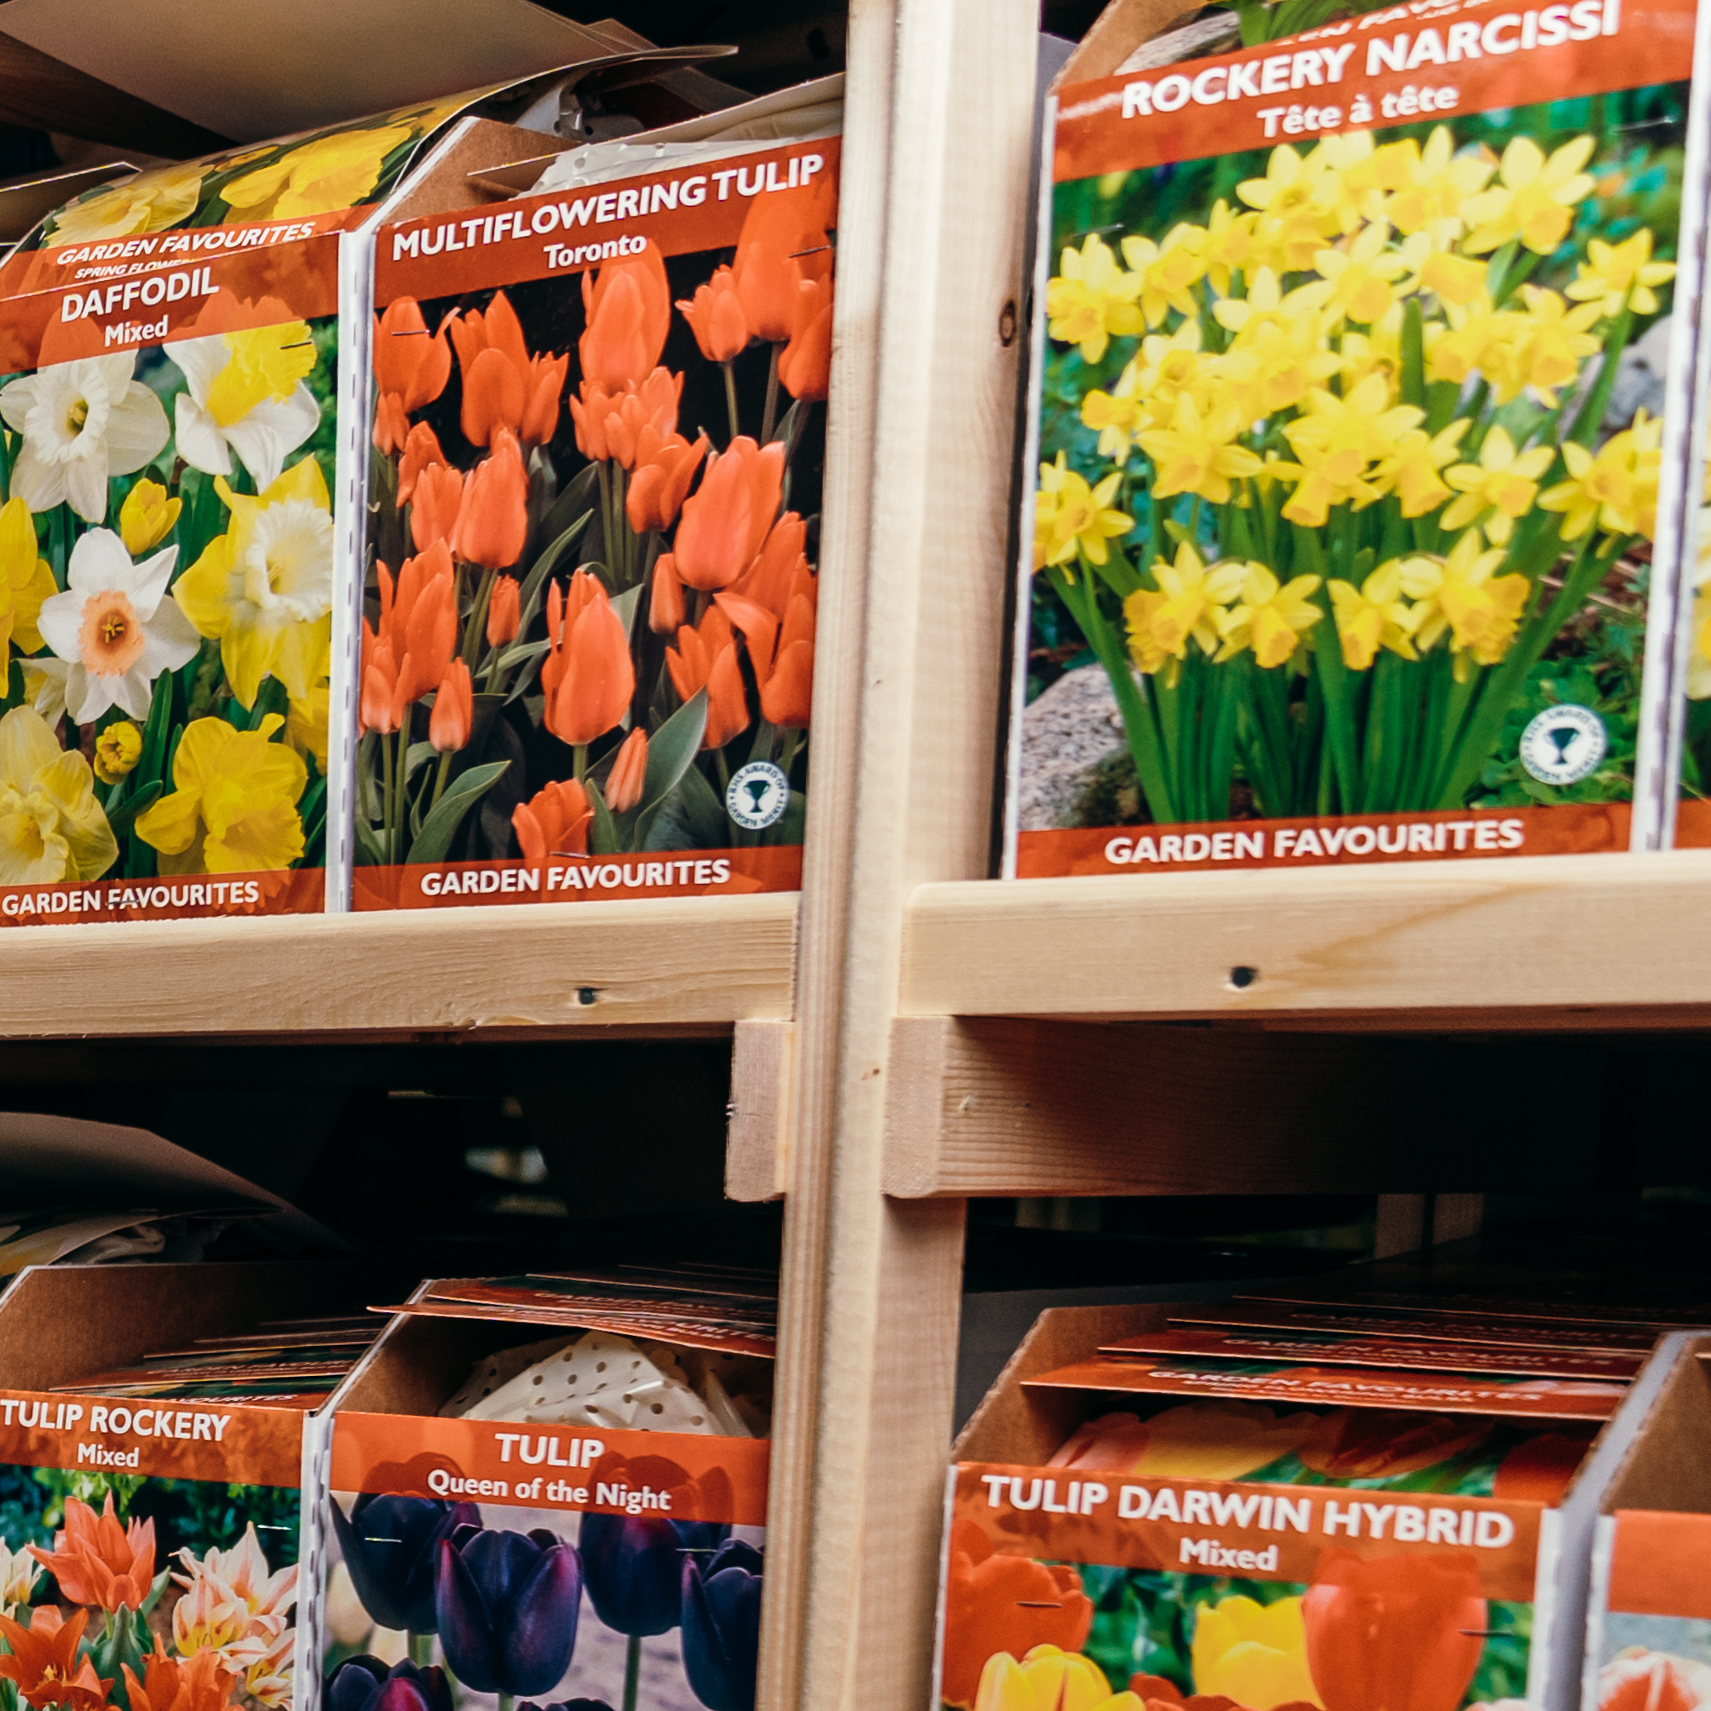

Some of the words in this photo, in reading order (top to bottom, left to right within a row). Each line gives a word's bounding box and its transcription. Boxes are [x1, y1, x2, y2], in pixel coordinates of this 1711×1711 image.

[1121, 44, 1356, 119] ROCKERY
[1365, 0, 1619, 77] NARCISSI
[1257, 108, 1342, 138] Tête
[1349, 94, 1373, 125] à
[1381, 86, 1459, 119] tête
[392, 176, 708, 260] MULTIFLOWERING
[712, 154, 824, 201] TULIP
[57, 239, 159, 265] GARDEN
[160, 222, 316, 253] FAVOURITES
[543, 235, 647, 269] Toronto
[74, 265, 127, 279] SPRING
[60, 267, 219, 322] DAFFODIL
[104, 315, 168, 348] Mixed
[1104, 832, 1264, 865] GARDEN
[1273, 818, 1524, 858] FAVOURITES
[0, 889, 101, 917] GARDEN
[107, 881, 259, 912] FAVOURITES
[420, 868, 540, 898] GARDEN
[545, 858, 730, 893] FAVOURITES
[0, 1400, 82, 1429] TULIP
[89, 1409, 232, 1442] ROCKERY
[78, 1443, 140, 1468] Mixed
[495, 1433, 605, 1468] TULIP
[428, 1470, 509, 1498] Queen
[515, 1478, 541, 1500] of
[545, 1480, 589, 1504] the
[595, 1484, 671, 1514] Night
[981, 1475, 1108, 1515] TULIP
[1118, 1486, 1310, 1533] DARWIN
[1322, 1498, 1514, 1547] HYBRID
[1178, 1536, 1278, 1572] Mixed
